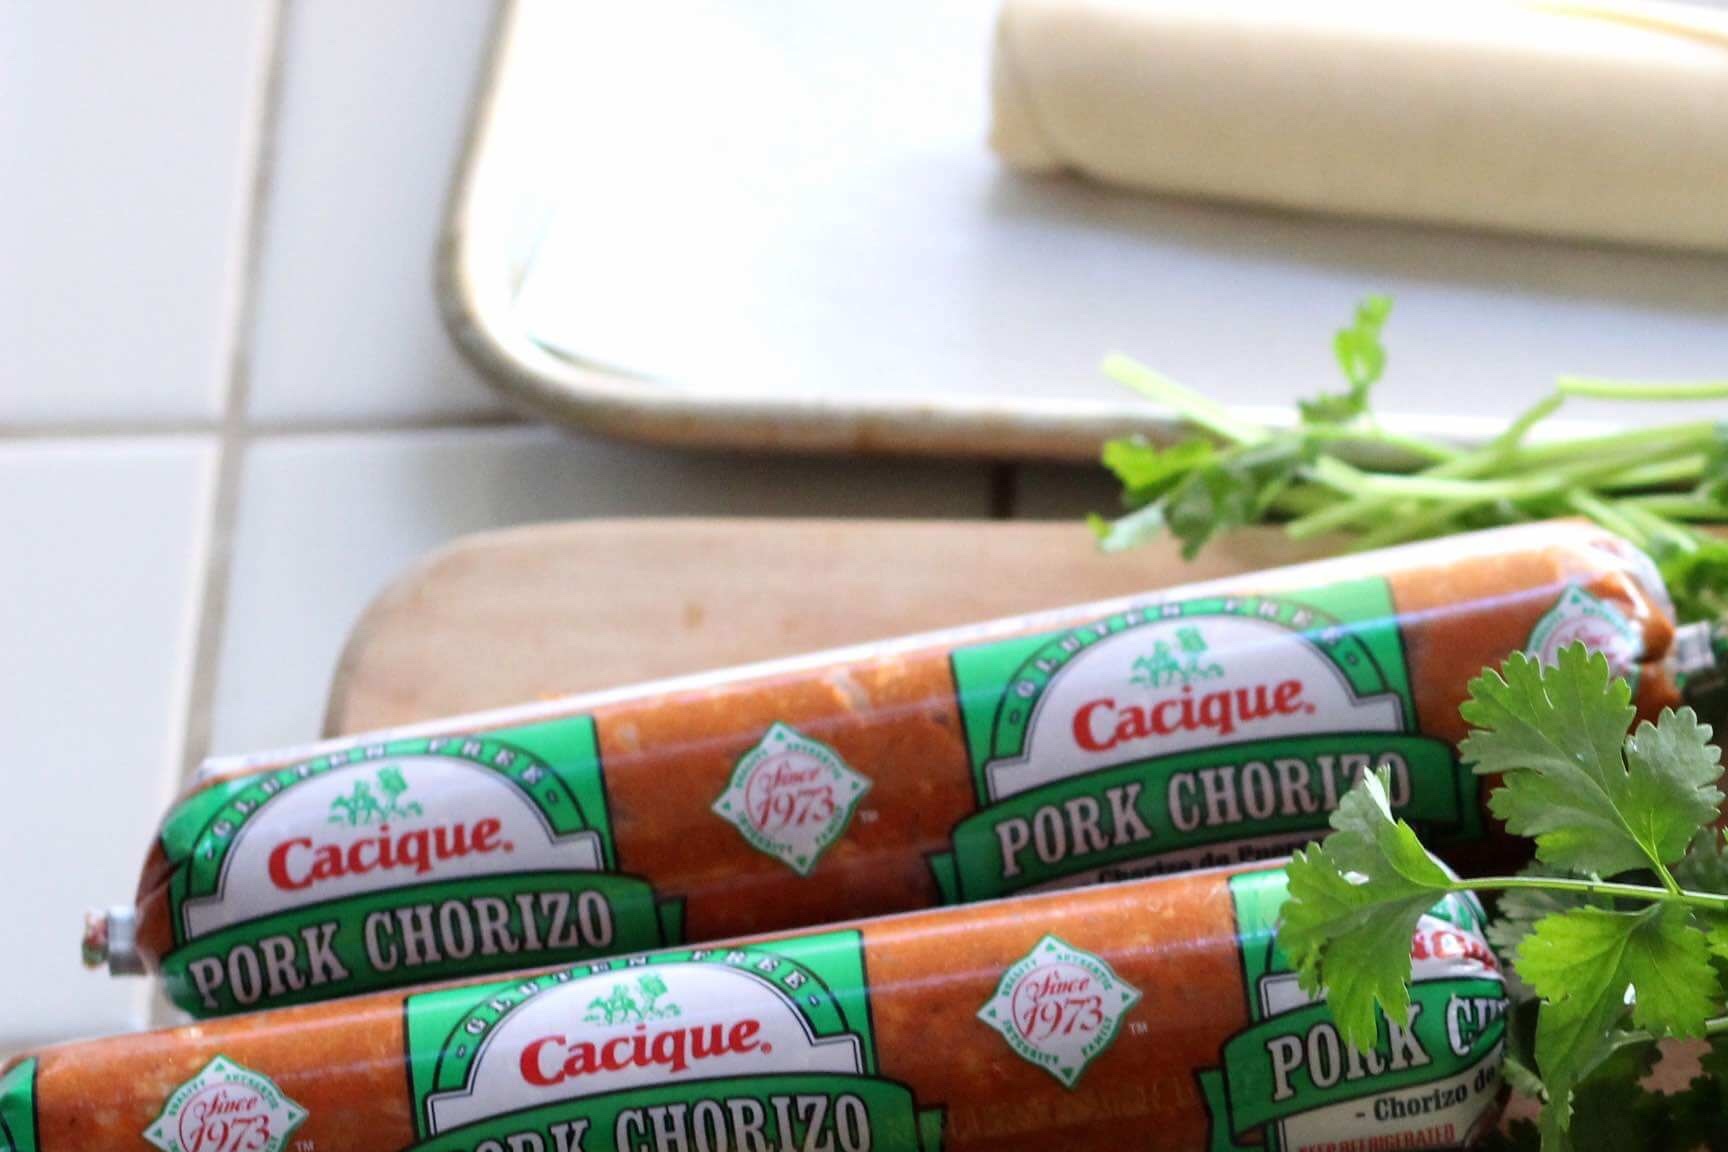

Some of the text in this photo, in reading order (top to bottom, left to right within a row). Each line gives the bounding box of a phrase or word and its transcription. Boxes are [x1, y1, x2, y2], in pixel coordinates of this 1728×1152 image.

[757, 785, 835, 831] 1973
[995, 783, 1152, 879] PORK
[188, 889, 615, 1009] PORK CHORIZO
[1024, 970, 1091, 999] Since
[1022, 994, 1104, 1041] 1973
[192, 1088, 260, 1119] Since
[1374, 1083, 1468, 1122] Chorizo
